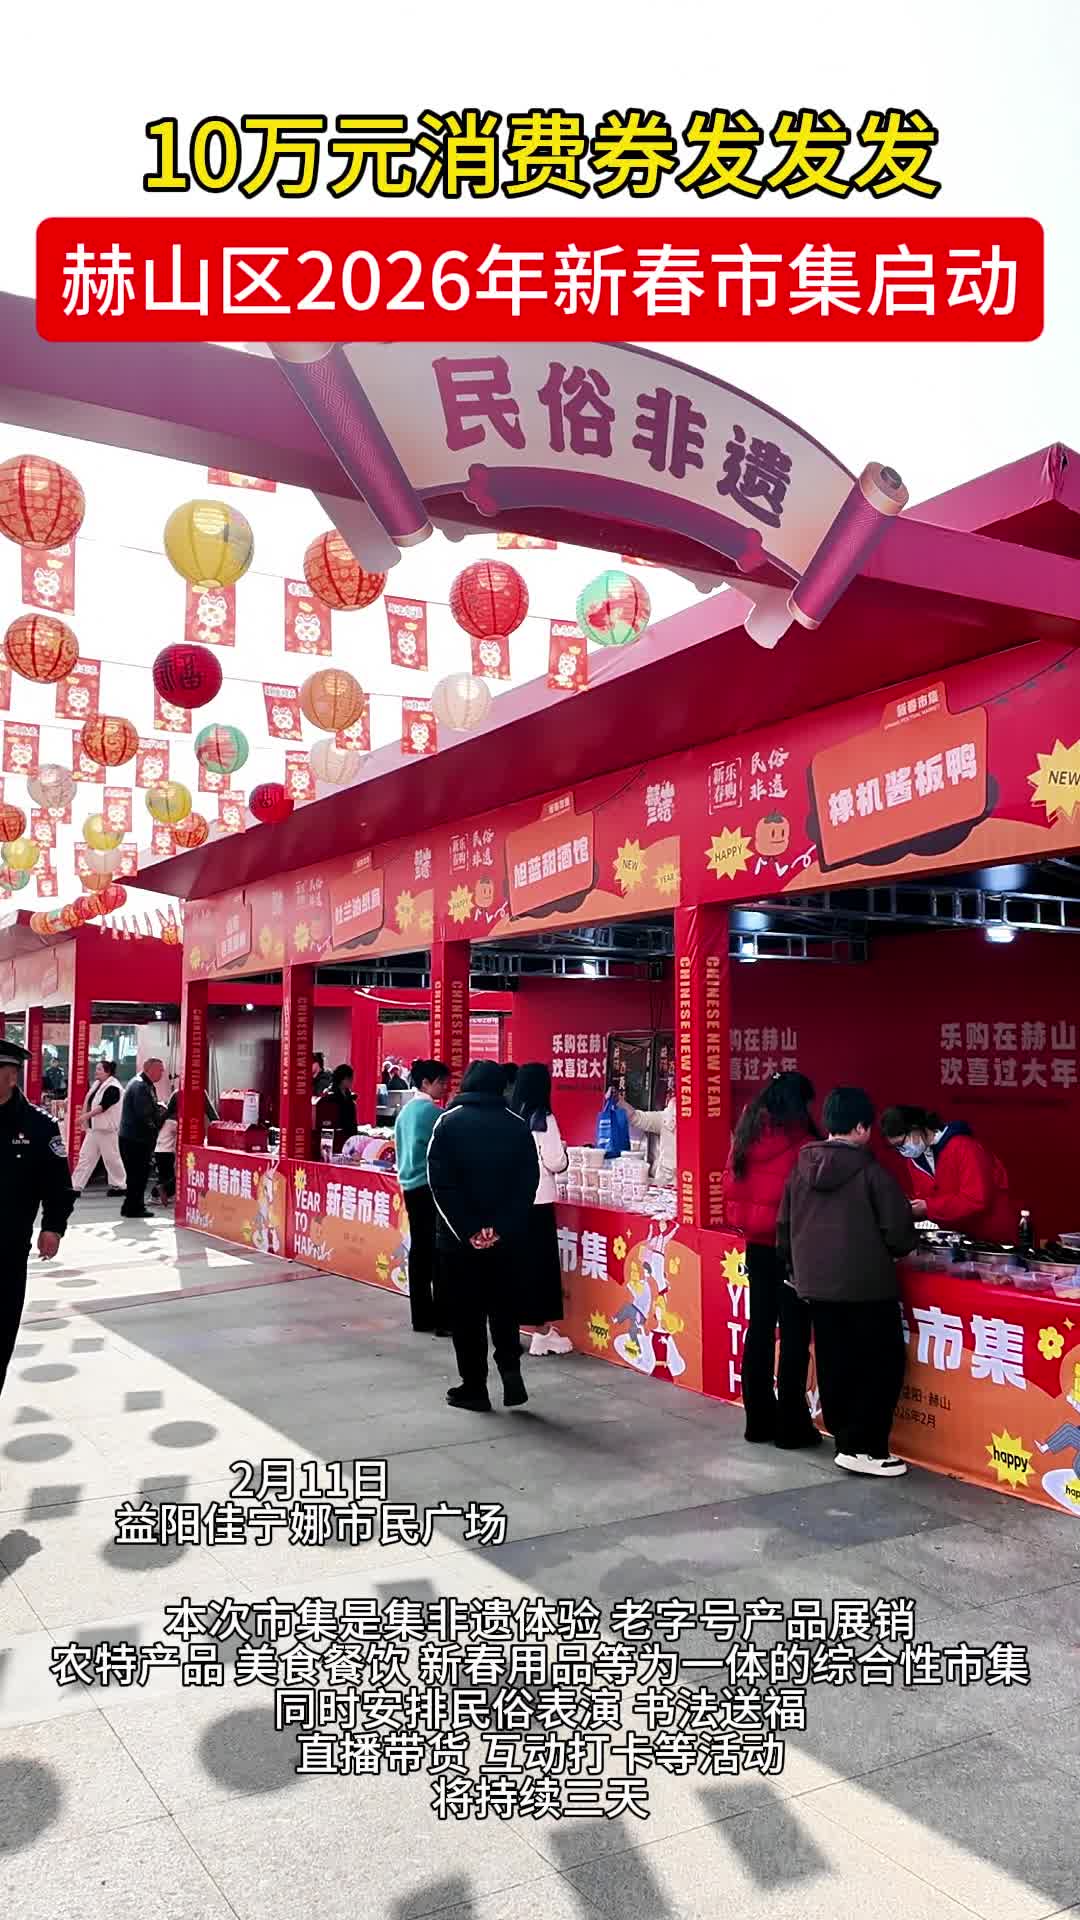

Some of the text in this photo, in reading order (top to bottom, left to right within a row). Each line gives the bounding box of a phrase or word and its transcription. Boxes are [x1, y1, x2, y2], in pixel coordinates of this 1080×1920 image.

[431, 355, 793, 529] 民俗非遗
[622, 859, 640, 871] NEW
[714, 844, 743, 863] HAPPY
[451, 981, 463, 1036] CHINESE
[680, 956, 693, 1118] CHINESE NEW YEAR
[706, 956, 721, 1118] CHINESE NEW YEAR
[940, 1020, 1077, 1051] 乐购在赫山
[451, 1039, 463, 1068] NEW
[940, 1056, 1078, 1088] 欢喜过大年
[187, 1187, 197, 1206] TO
[207, 1162, 252, 1201] 新春市集
[295, 1188, 321, 1213] YEAR
[326, 1182, 391, 1229] 新春市集
[295, 1211, 308, 1233] TO
[556, 1227, 609, 1282] 市集
[992, 1444, 1029, 1473] happy
